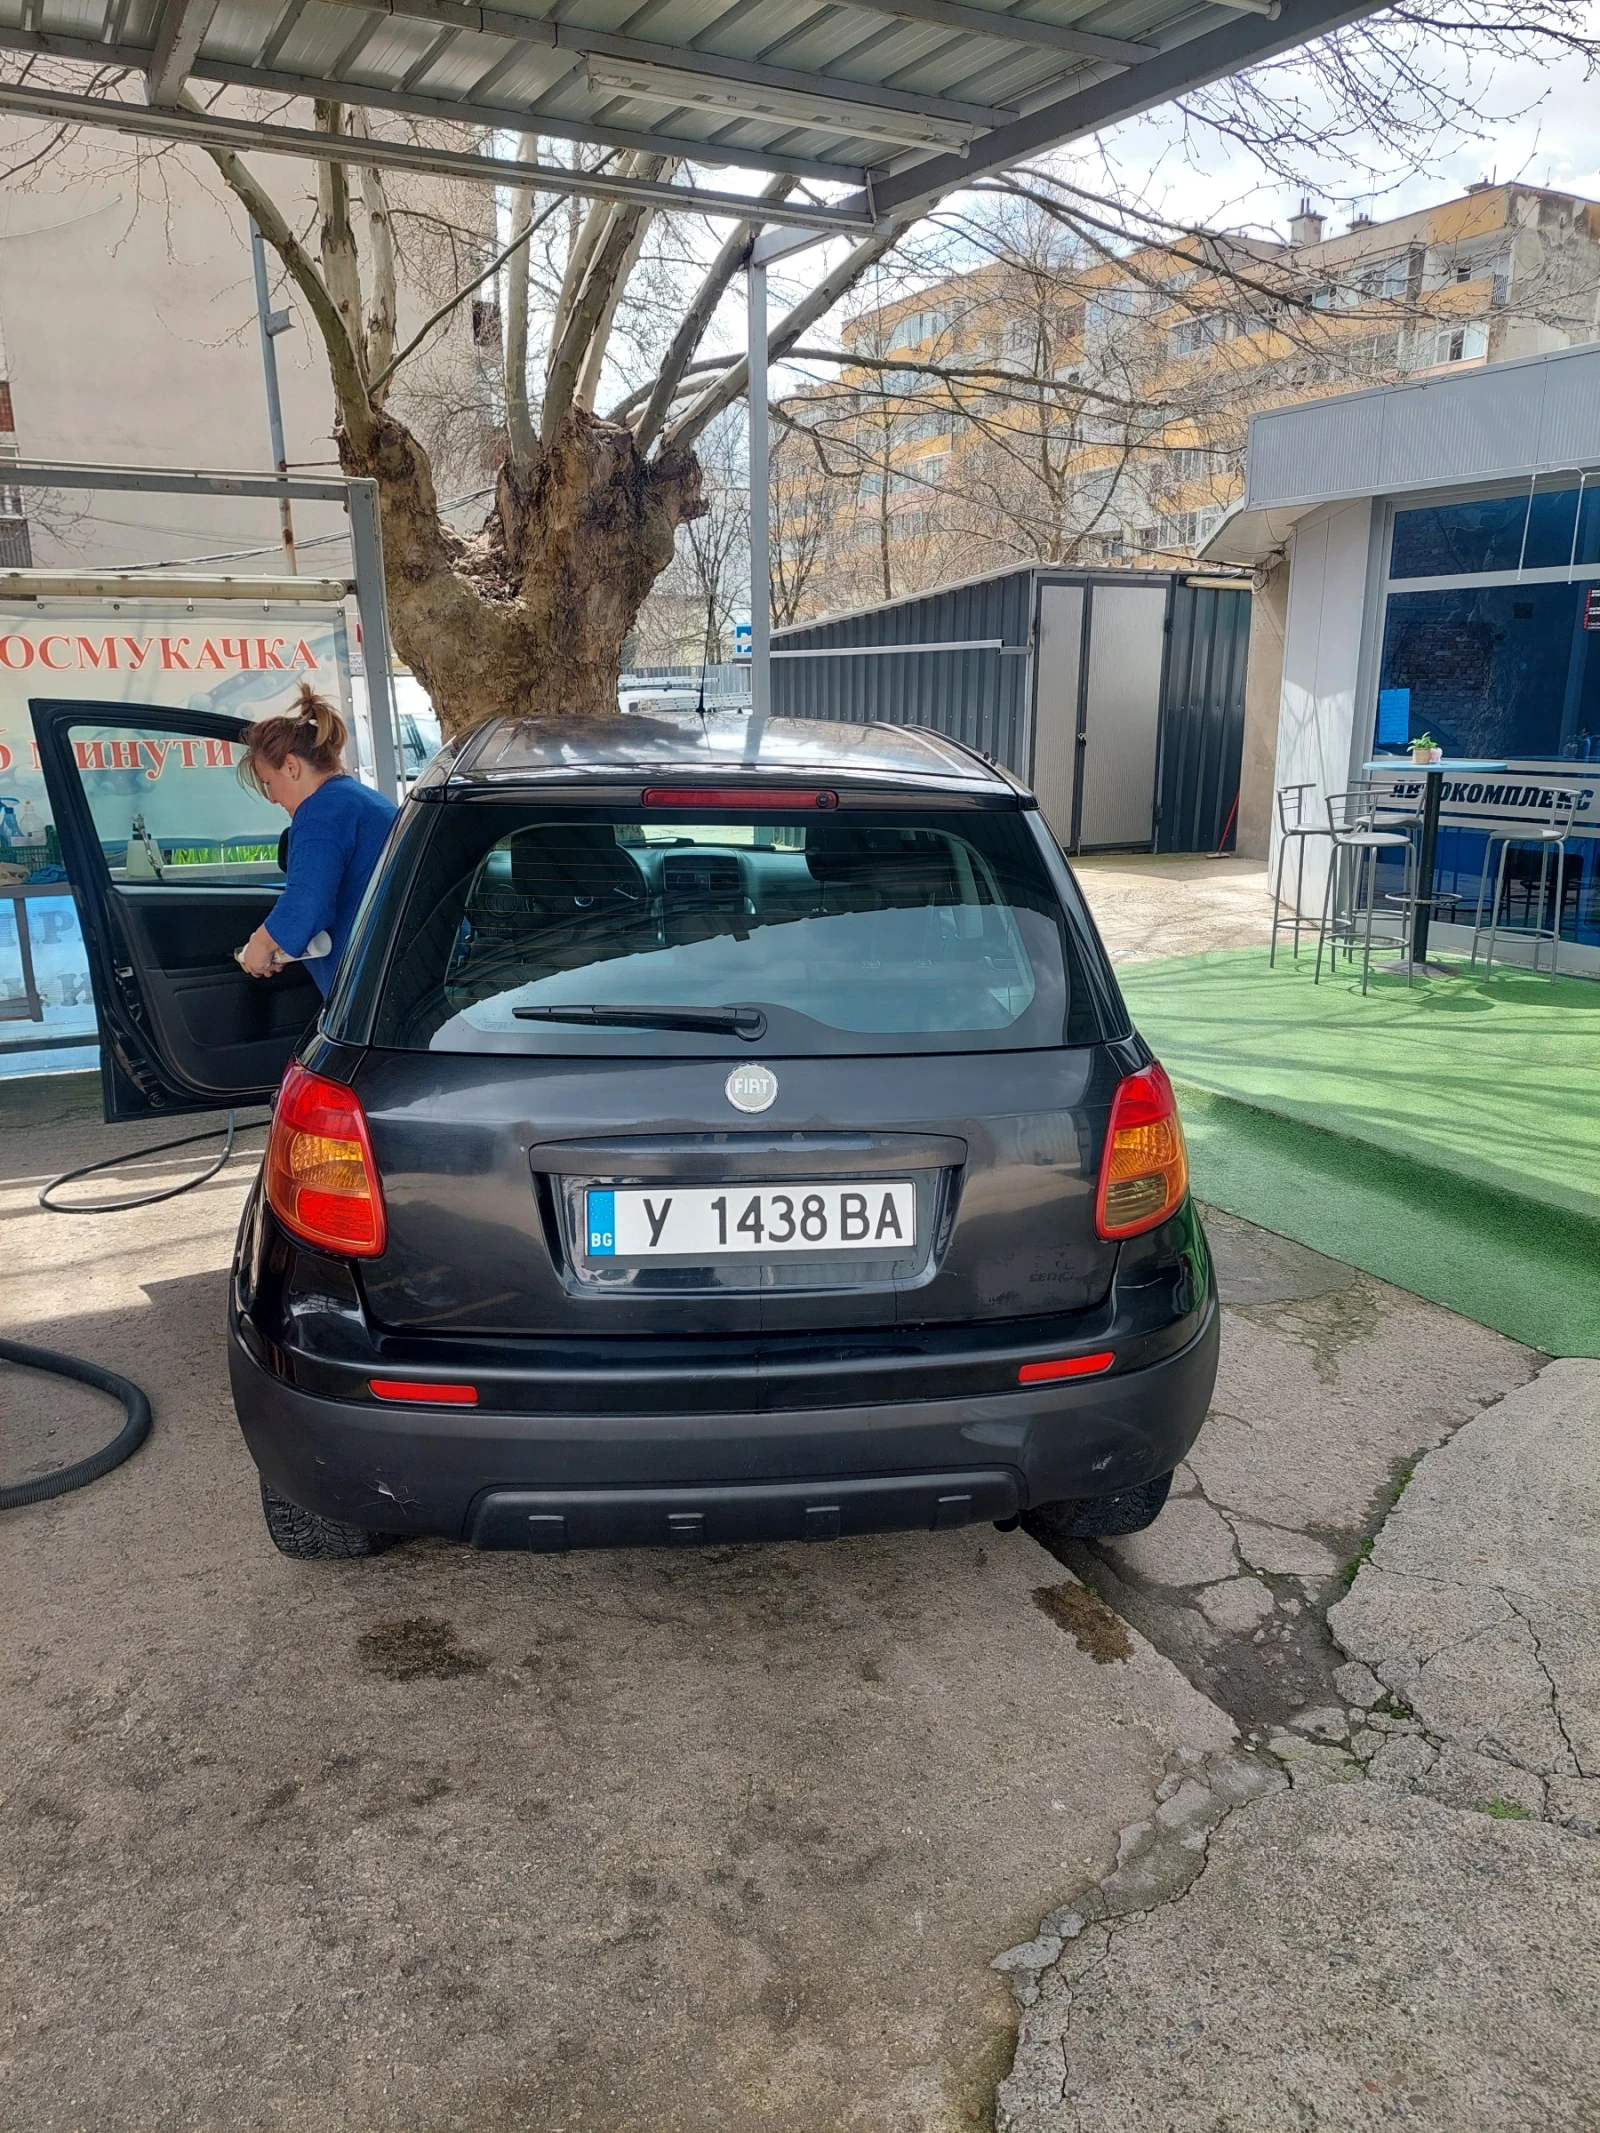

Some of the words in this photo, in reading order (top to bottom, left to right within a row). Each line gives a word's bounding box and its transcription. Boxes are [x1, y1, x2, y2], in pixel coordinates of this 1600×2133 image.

[0, 634, 321, 671] ОСМУКАЧКА
[1389, 779, 1594, 811] АВОКОМПЛЕКС
[734, 1078, 770, 1095] FIAT
[591, 1232, 613, 1248] BG
